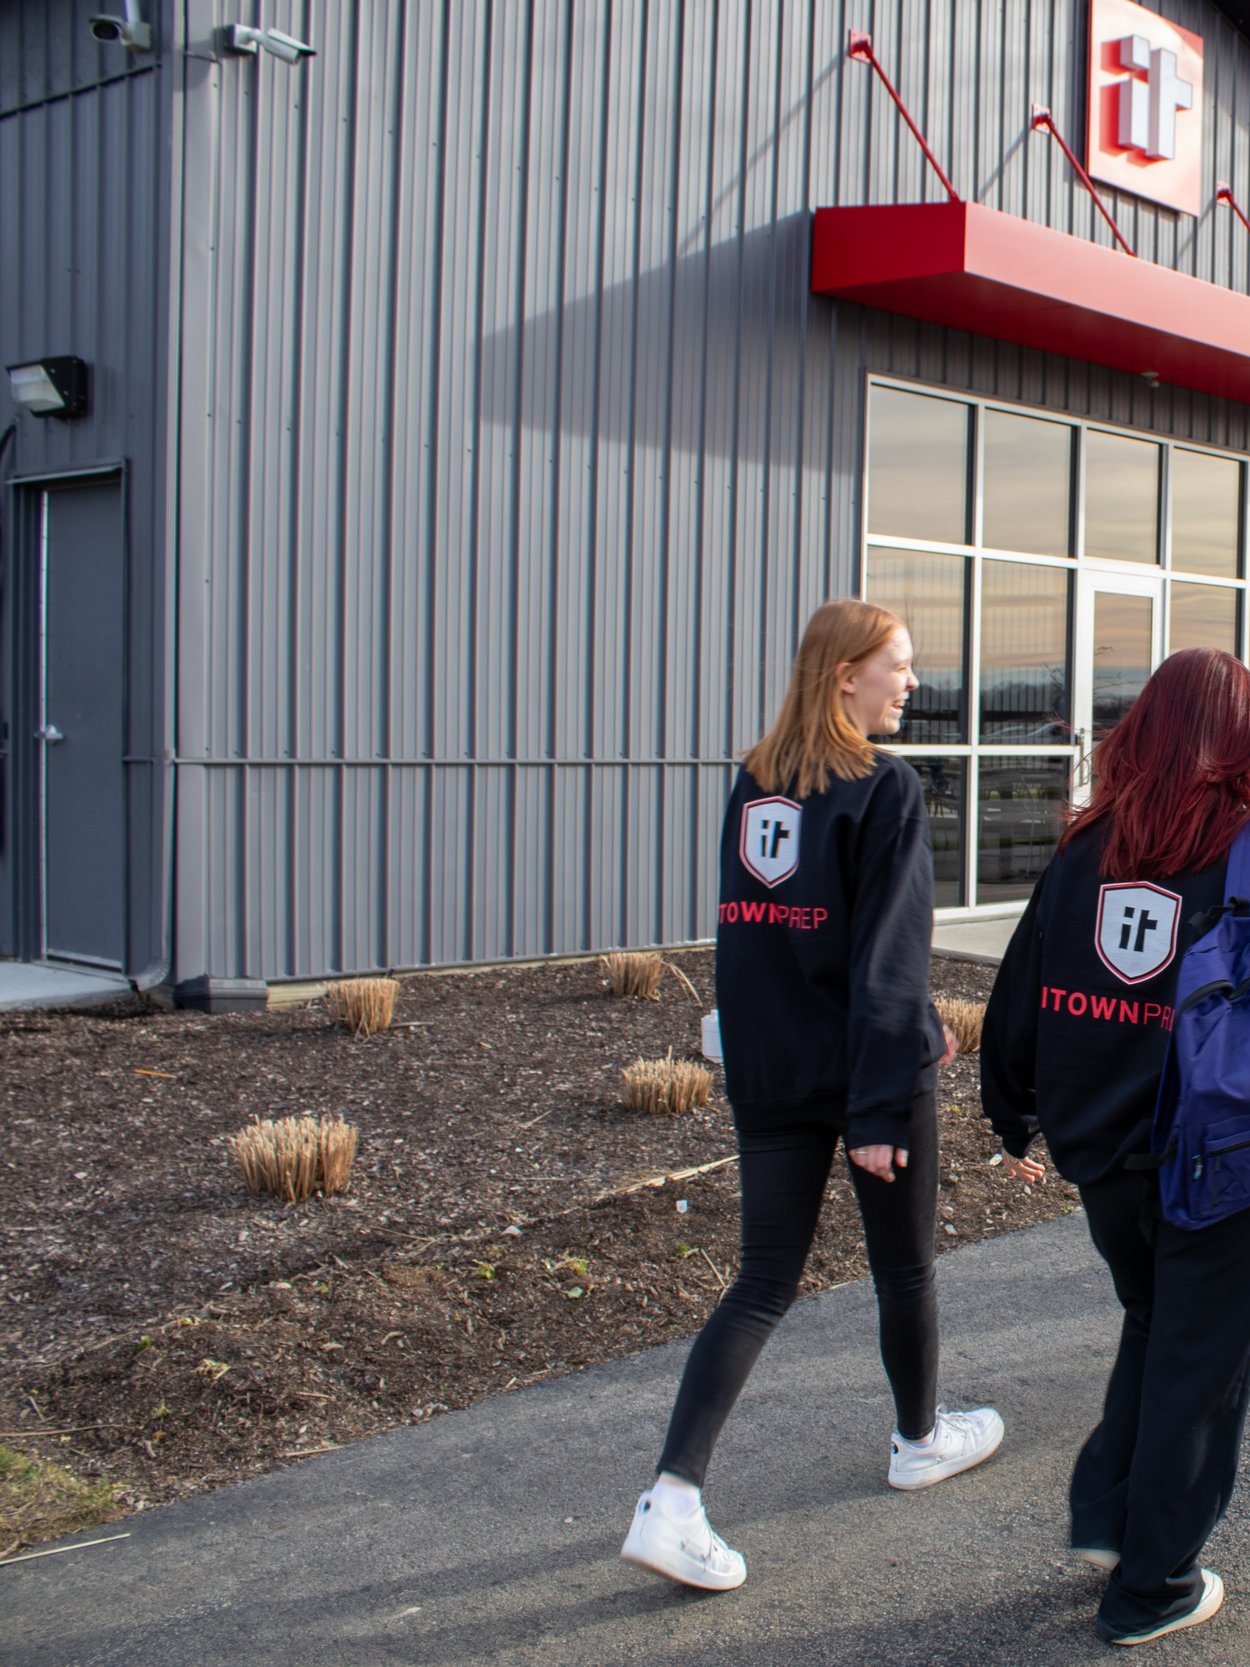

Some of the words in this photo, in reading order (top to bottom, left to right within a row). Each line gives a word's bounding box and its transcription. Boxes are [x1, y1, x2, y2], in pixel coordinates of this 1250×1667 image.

[1118, 34, 1193, 160] it
[760, 819, 790, 858] it
[719, 900, 828, 929] TOWNPREP
[1119, 906, 1158, 952] it
[1041, 986, 1176, 1032] ITOWNPR
